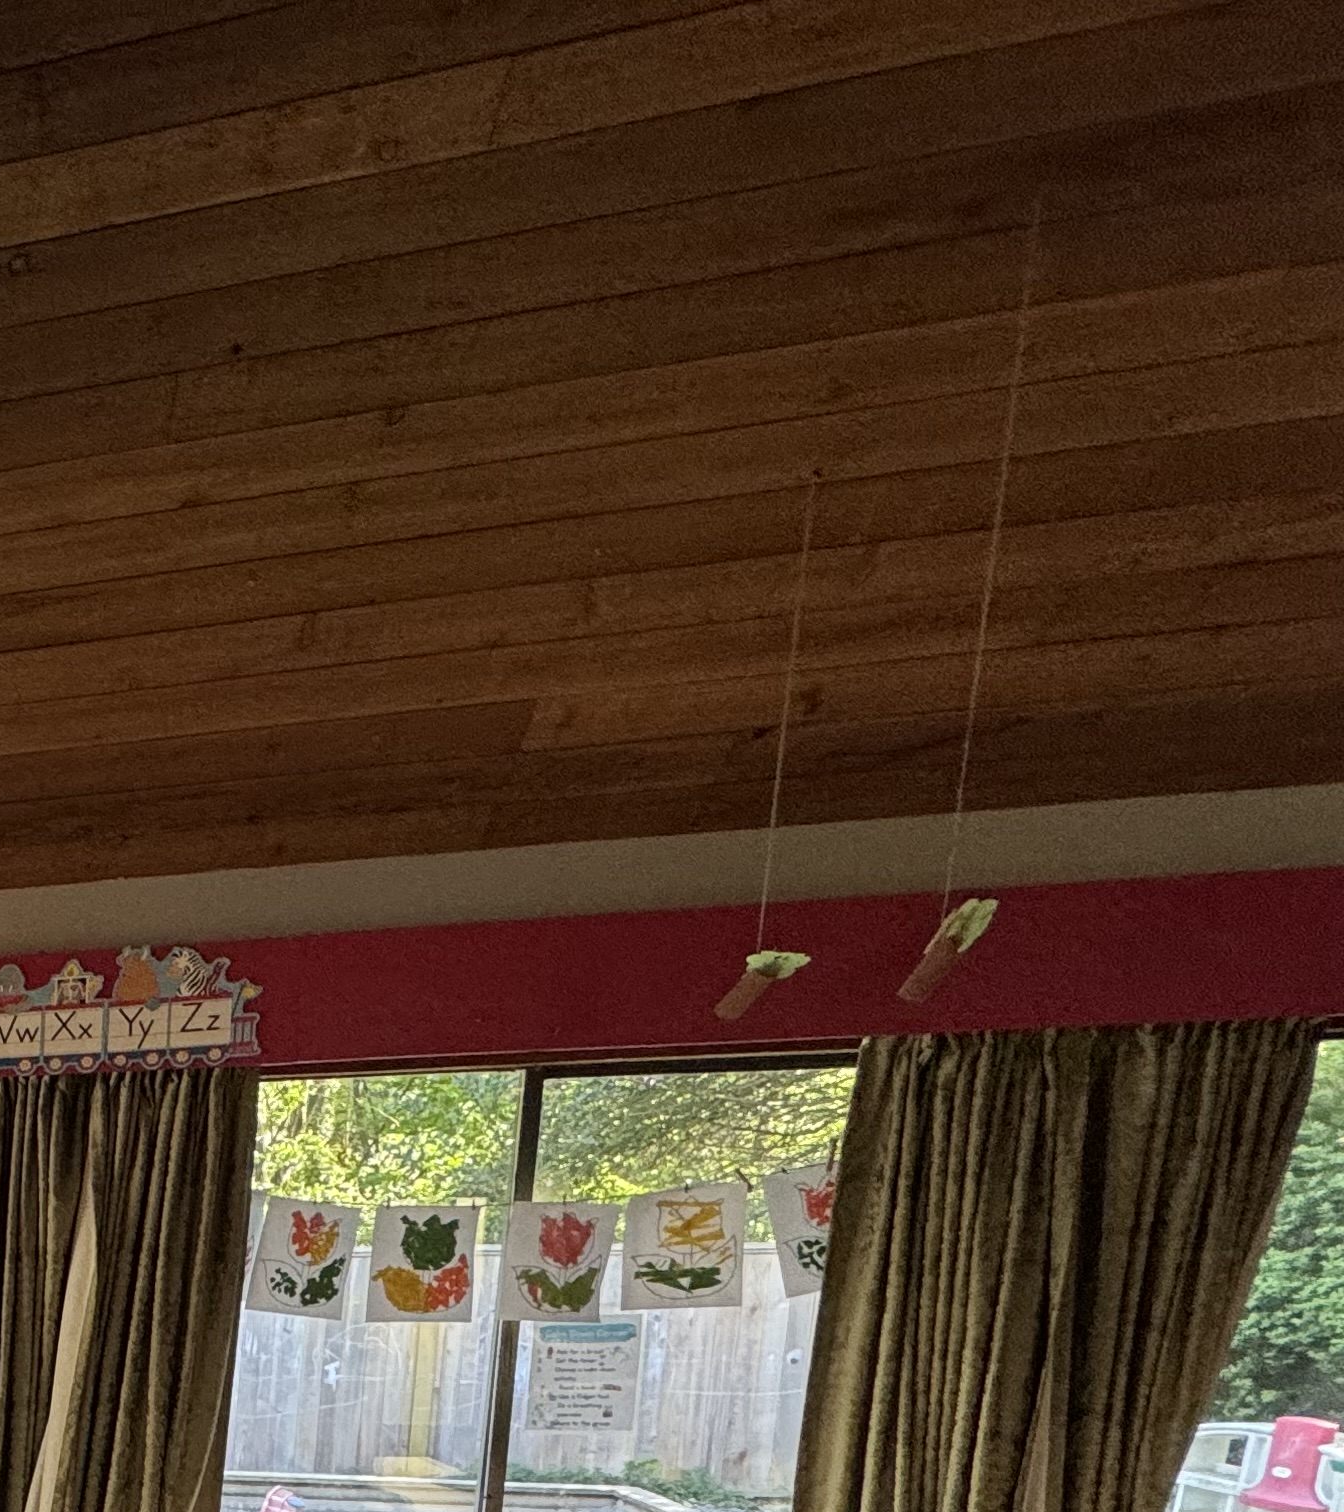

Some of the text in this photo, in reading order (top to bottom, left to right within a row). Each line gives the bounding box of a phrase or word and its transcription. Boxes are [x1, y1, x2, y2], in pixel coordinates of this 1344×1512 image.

[51, 1012, 92, 1040] Xx
[119, 1008, 153, 1049] Yy
[181, 1003, 220, 1032] Zz
